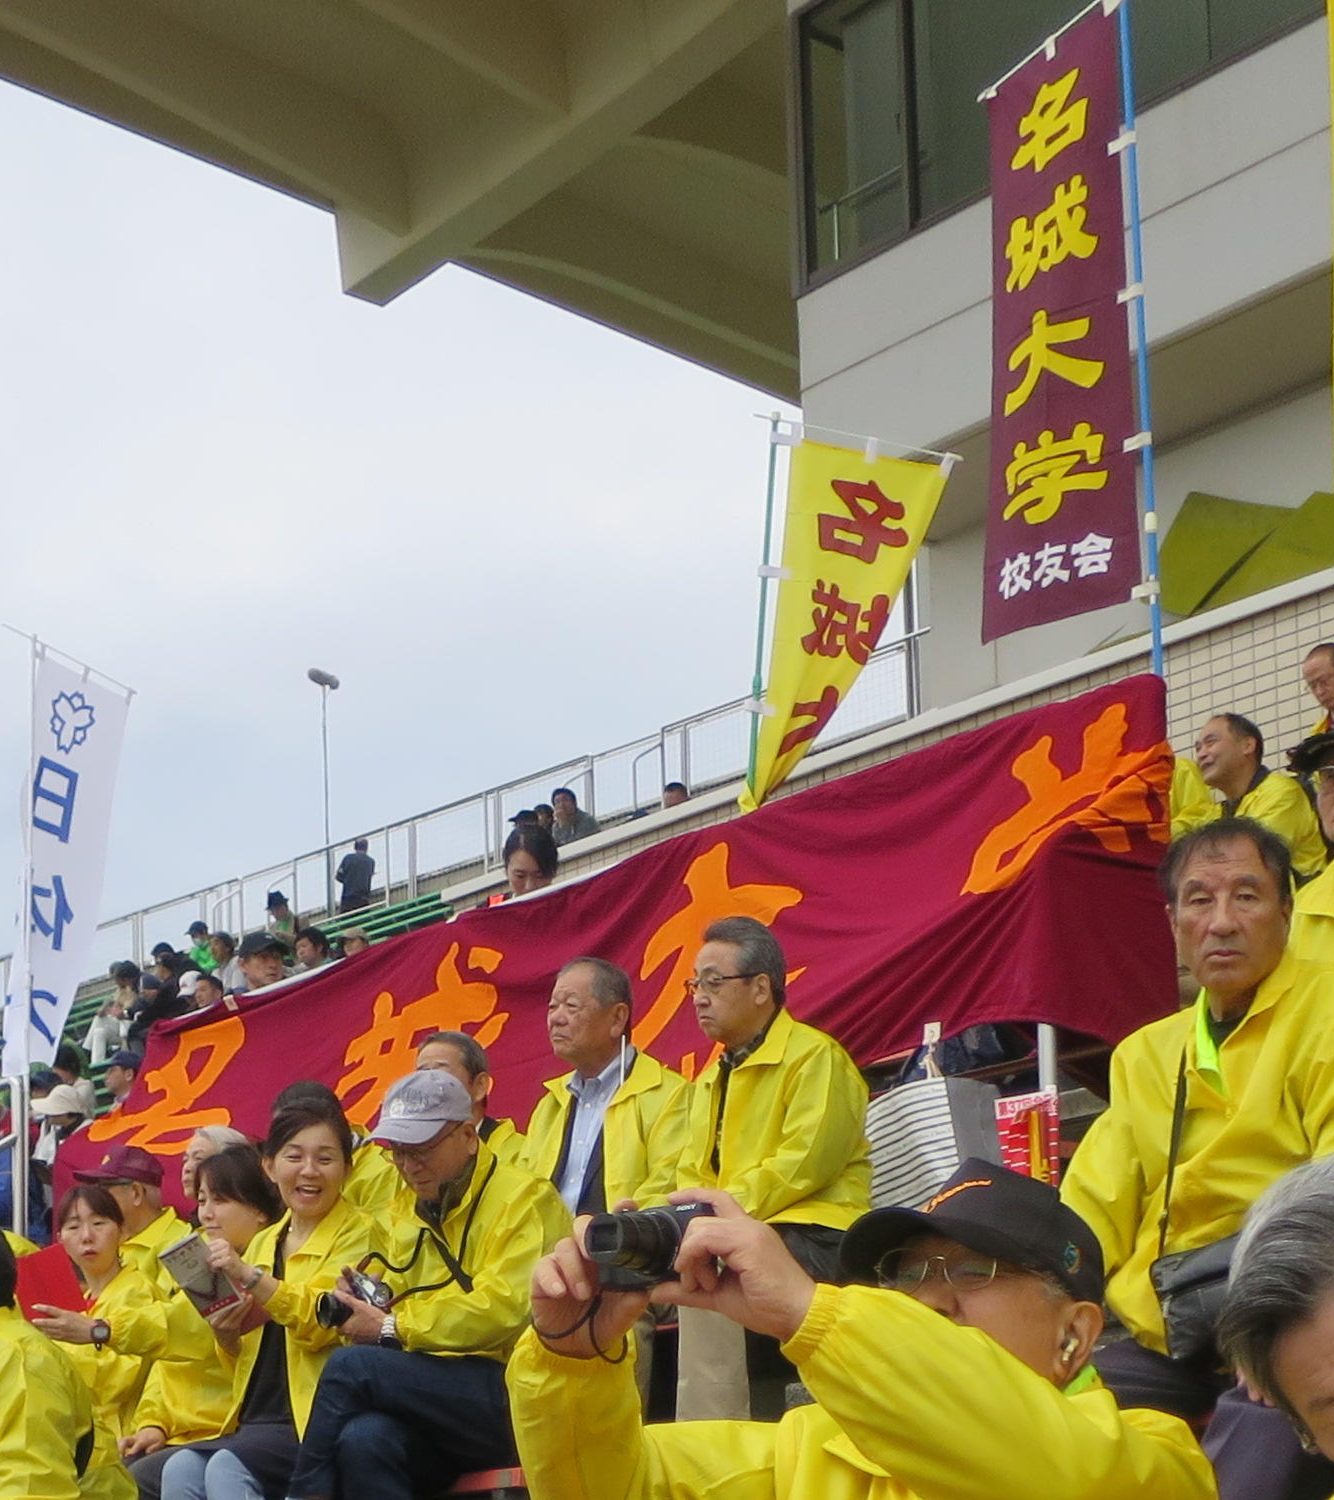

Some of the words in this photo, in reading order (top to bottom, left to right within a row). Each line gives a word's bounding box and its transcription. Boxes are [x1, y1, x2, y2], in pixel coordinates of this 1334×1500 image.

[1003, 67, 1109, 525] 名城大学
[998, 530, 1115, 601] 校友会
